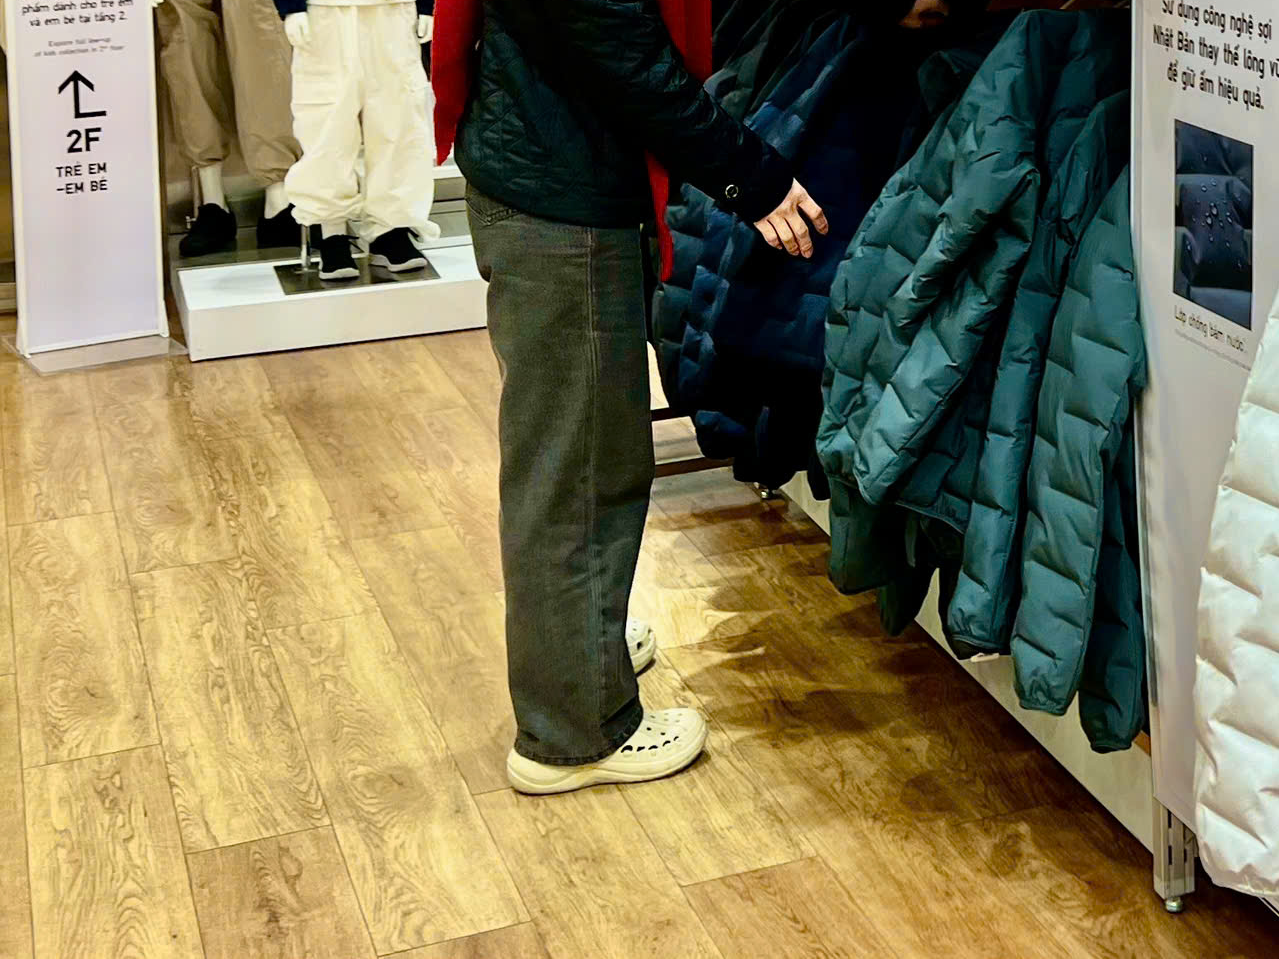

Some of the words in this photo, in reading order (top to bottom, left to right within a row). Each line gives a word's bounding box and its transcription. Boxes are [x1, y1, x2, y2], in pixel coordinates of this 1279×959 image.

[1203, 5, 1225, 33] công
[1230, 13, 1253, 40] nghệ
[1258, 19, 1272, 44] sợi
[1153, 24, 1173, 52] Nhật
[1178, 31, 1194, 54] Bản
[1199, 37, 1219, 65] thay
[1223, 43, 1240, 66] thế
[1244, 48, 1264, 79] lông
[66, 127, 102, 153] 2F
[88, 162, 107, 174] EM
